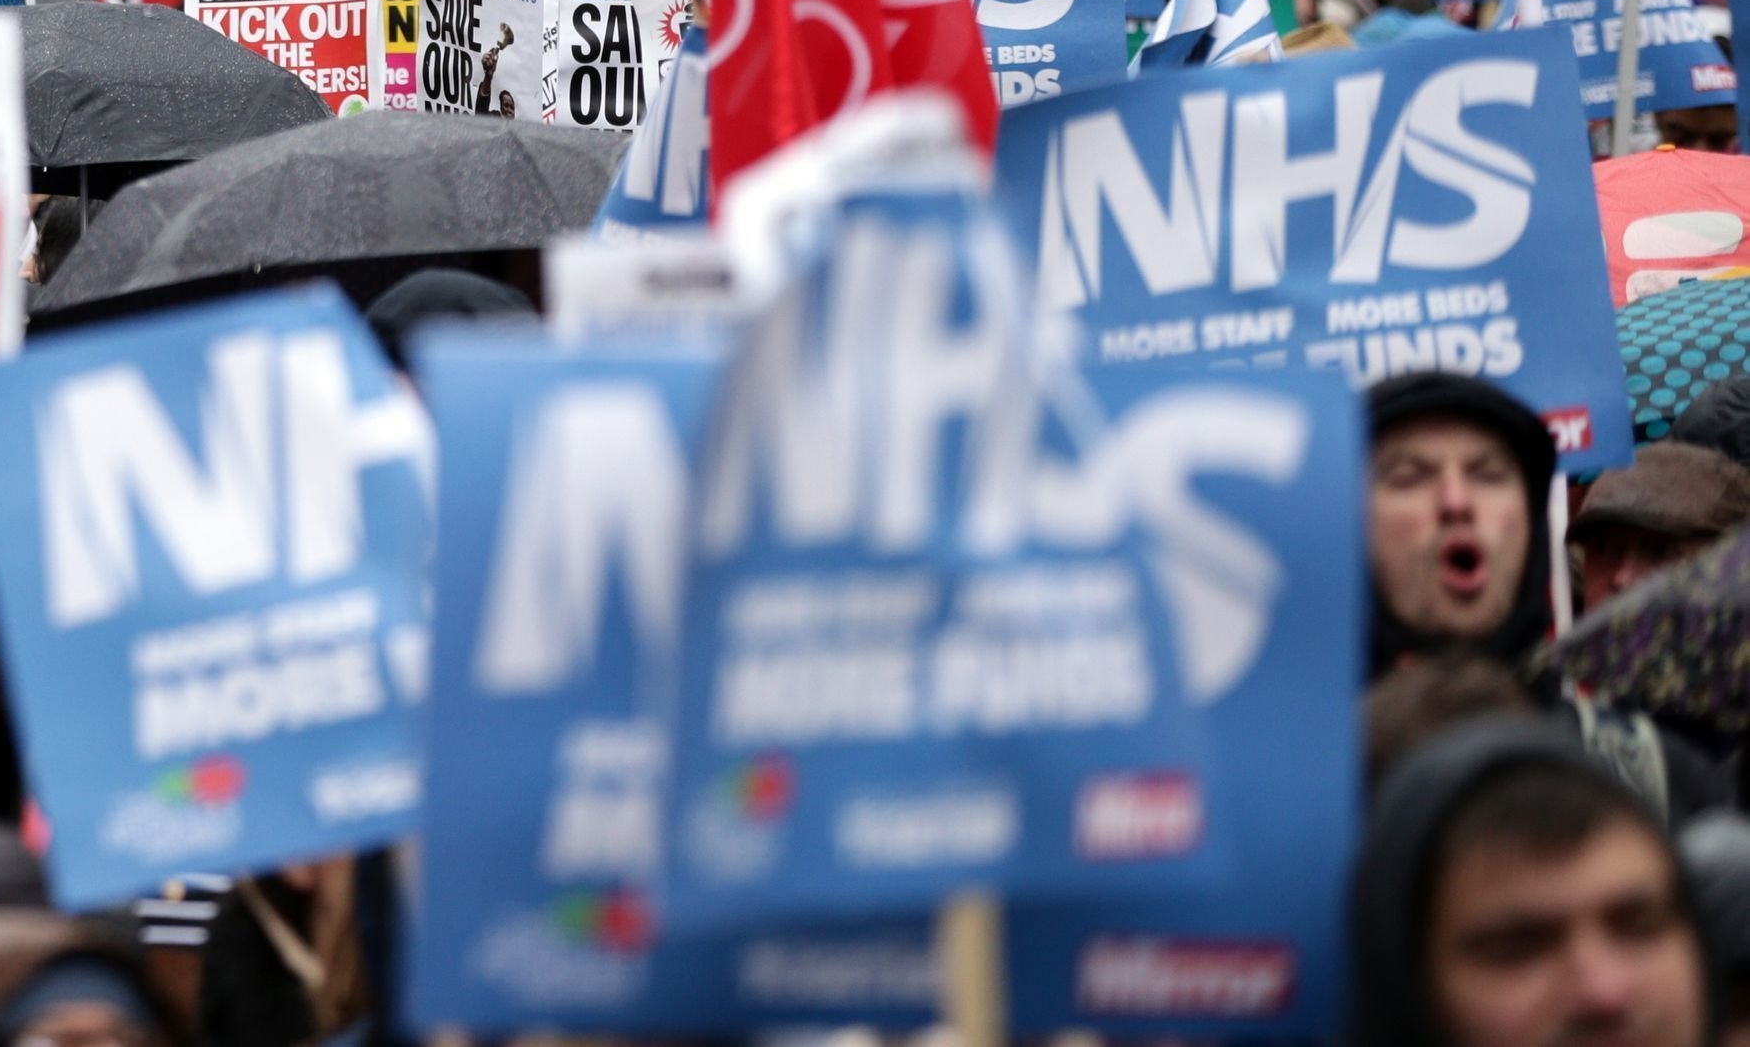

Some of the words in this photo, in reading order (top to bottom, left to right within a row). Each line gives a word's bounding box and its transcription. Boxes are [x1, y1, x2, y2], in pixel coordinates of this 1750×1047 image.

[201, 5, 292, 43] KICK
[299, 1, 367, 41] OUT
[262, 41, 315, 68] THE
[422, 41, 473, 110] OUR
[997, 43, 1056, 65] BEDS
[1037, 59, 1539, 310] NHS
[1201, 307, 1294, 351] STAFF
[1327, 291, 1421, 335] MORE
[1426, 280, 1509, 321] BEDS
